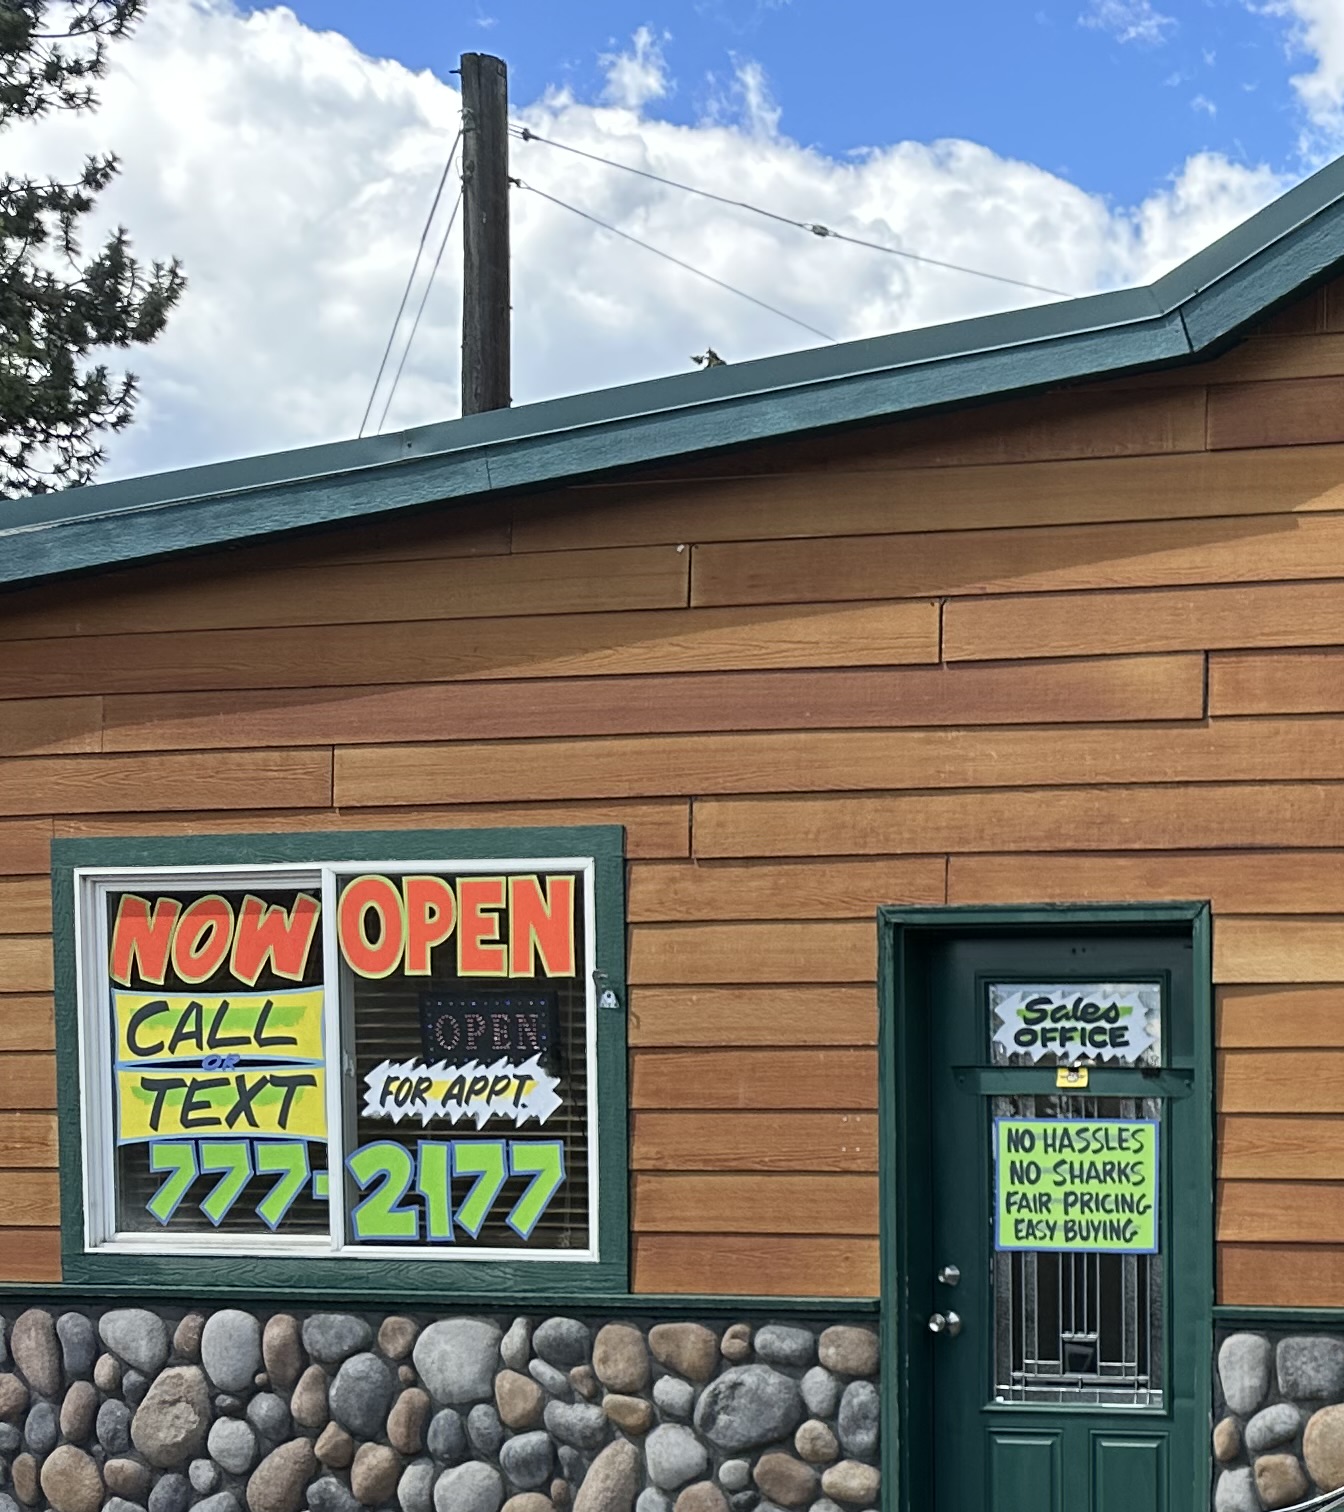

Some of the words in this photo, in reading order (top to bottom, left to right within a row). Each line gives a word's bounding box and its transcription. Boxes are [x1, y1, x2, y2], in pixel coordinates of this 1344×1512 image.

[109, 892, 322, 988] NOW
[336, 873, 577, 980] OPEN
[1022, 996, 1120, 1026] Sales
[126, 999, 299, 1057] CALL
[433, 1013, 542, 1051] OPEN
[1013, 1025, 1130, 1049] OFFICE
[201, 1052, 241, 1072] OR
[140, 1073, 317, 1132] TEXT
[379, 1073, 431, 1109] FOR
[440, 1073, 529, 1109] APPT.
[1007, 1127, 1036, 1153] NO
[1043, 1126, 1146, 1155] HASSLES
[1009, 1159, 1042, 1186] NO
[1052, 1158, 1146, 1187] SHARKS
[1005, 1190, 1052, 1215] FAIR
[1063, 1190, 1153, 1216] PRICING
[1014, 1217, 1058, 1242] EASY
[1063, 1217, 1139, 1244] BUYING
